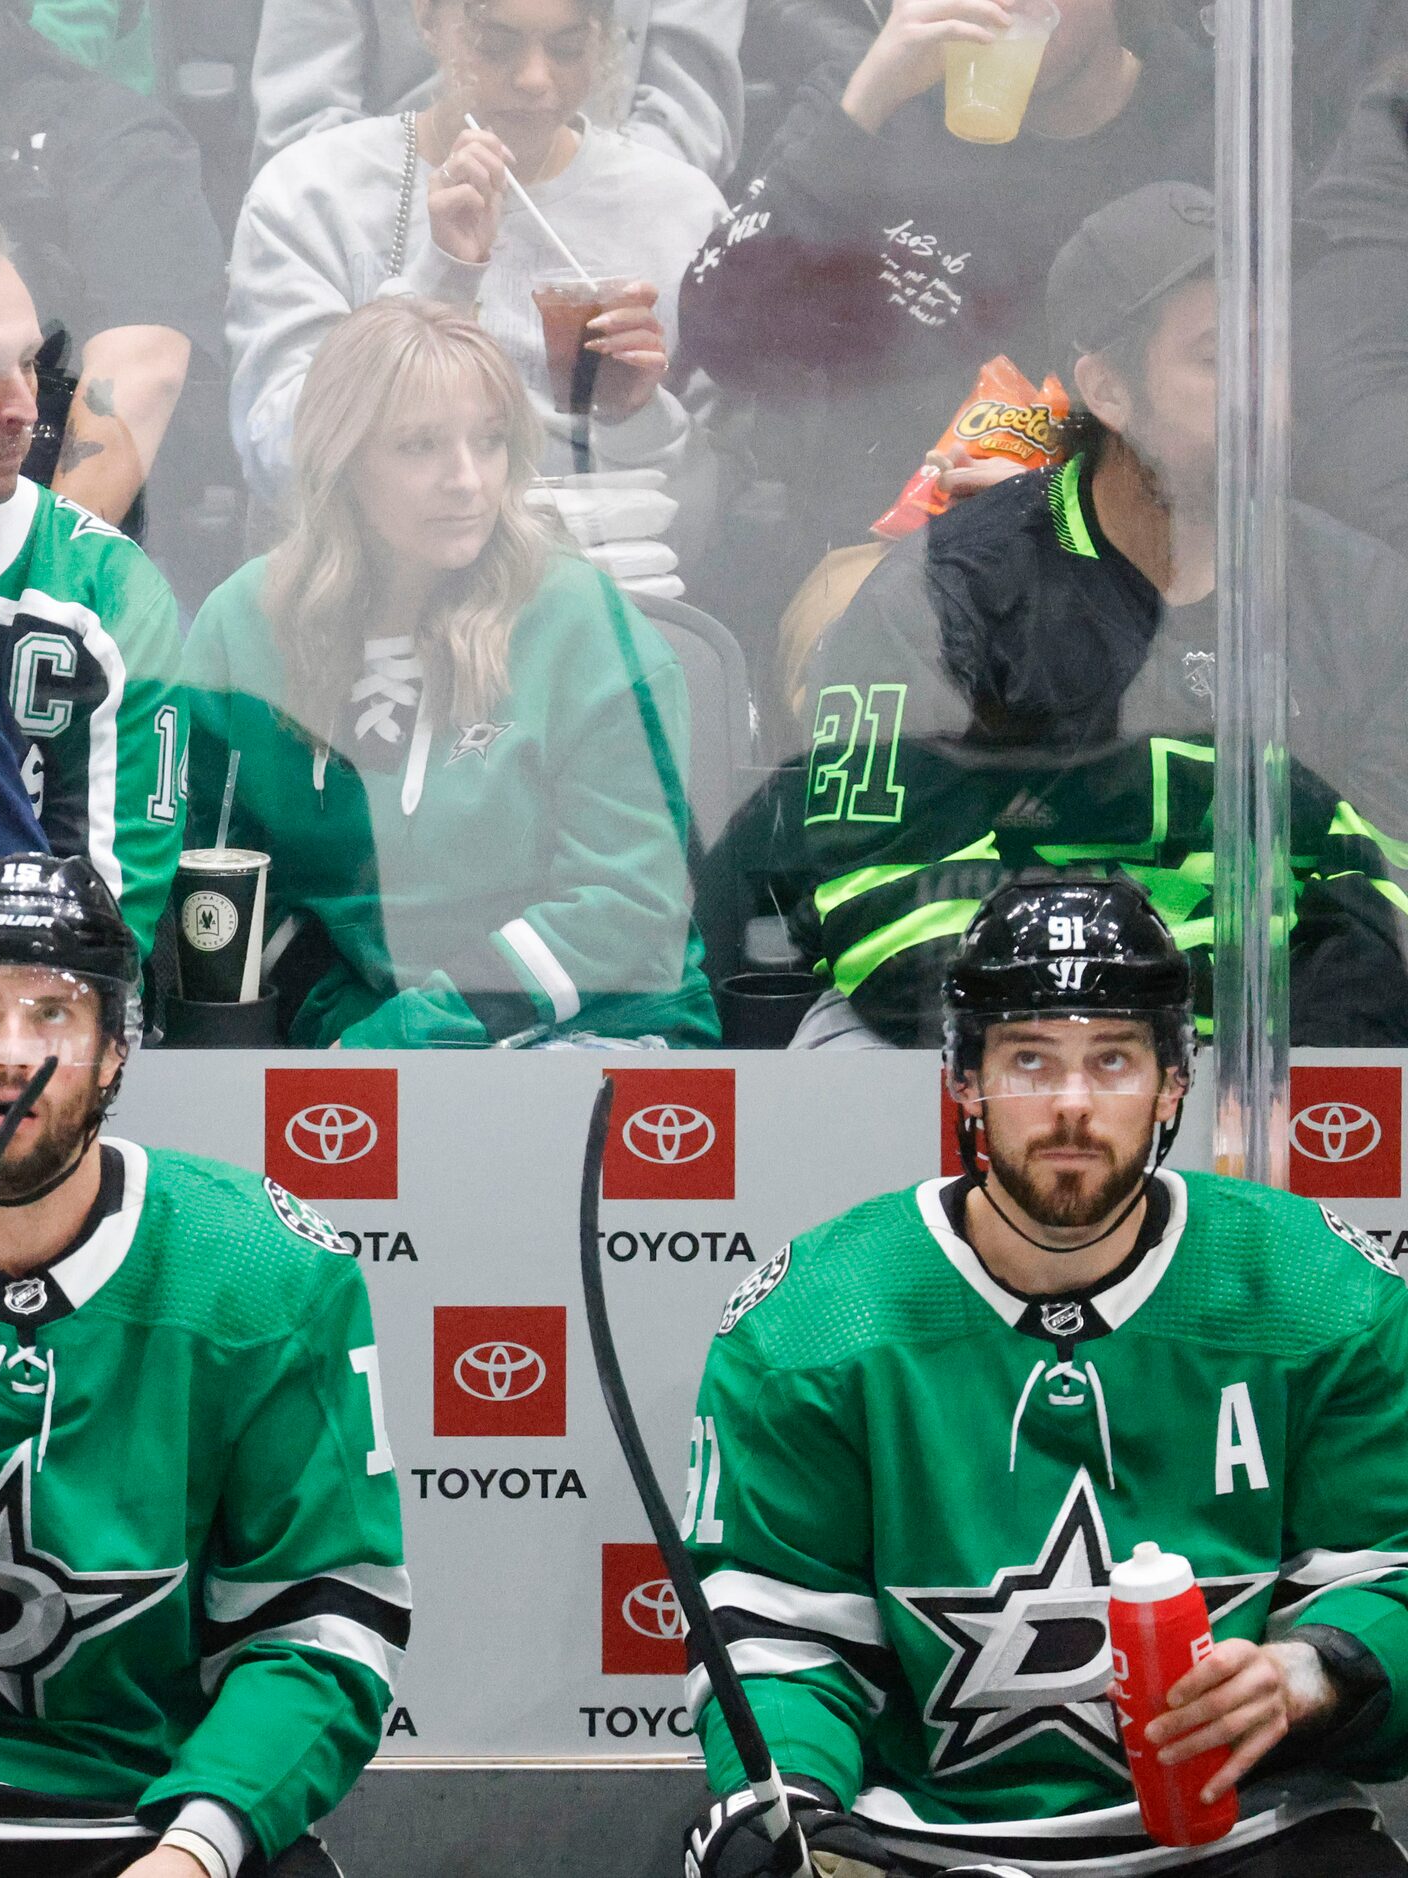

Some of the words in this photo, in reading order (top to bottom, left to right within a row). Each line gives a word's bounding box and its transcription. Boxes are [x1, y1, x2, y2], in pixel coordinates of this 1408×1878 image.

[956, 400, 1056, 446] Cheeto
[979, 436, 1035, 459] Crunchy
[9, 631, 77, 738] C
[147, 705, 189, 826] 1
[804, 684, 907, 827] 21
[1, 863, 42, 884] 15
[1048, 915, 1087, 950] 91
[338, 1231, 418, 1262] OTA
[598, 1231, 756, 1262] OYOTA
[1215, 1382, 1269, 1496] A
[411, 1467, 588, 1500] TOYOTA
[580, 1706, 695, 1738] TOYO
